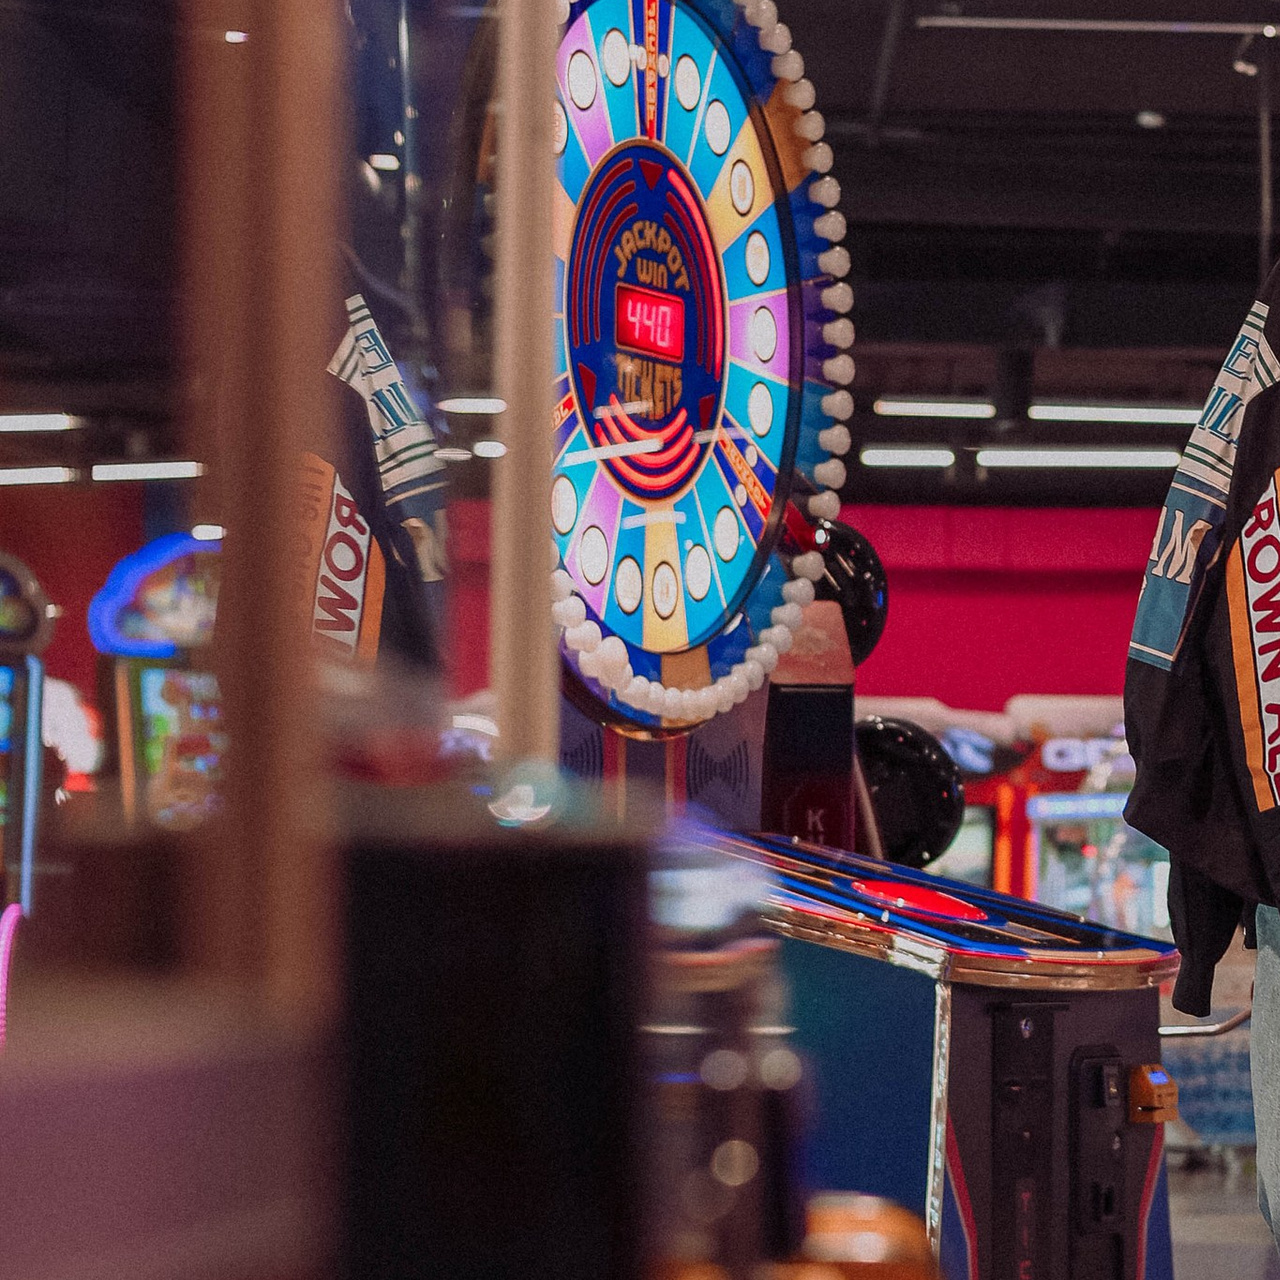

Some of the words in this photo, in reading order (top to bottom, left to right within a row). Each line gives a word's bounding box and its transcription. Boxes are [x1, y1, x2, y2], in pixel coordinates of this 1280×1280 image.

[614, 220, 690, 292] JACKPOT
[636, 256, 668, 290] WIN
[627, 298, 673, 348] 440
[615, 352, 683, 421] TICKETS
